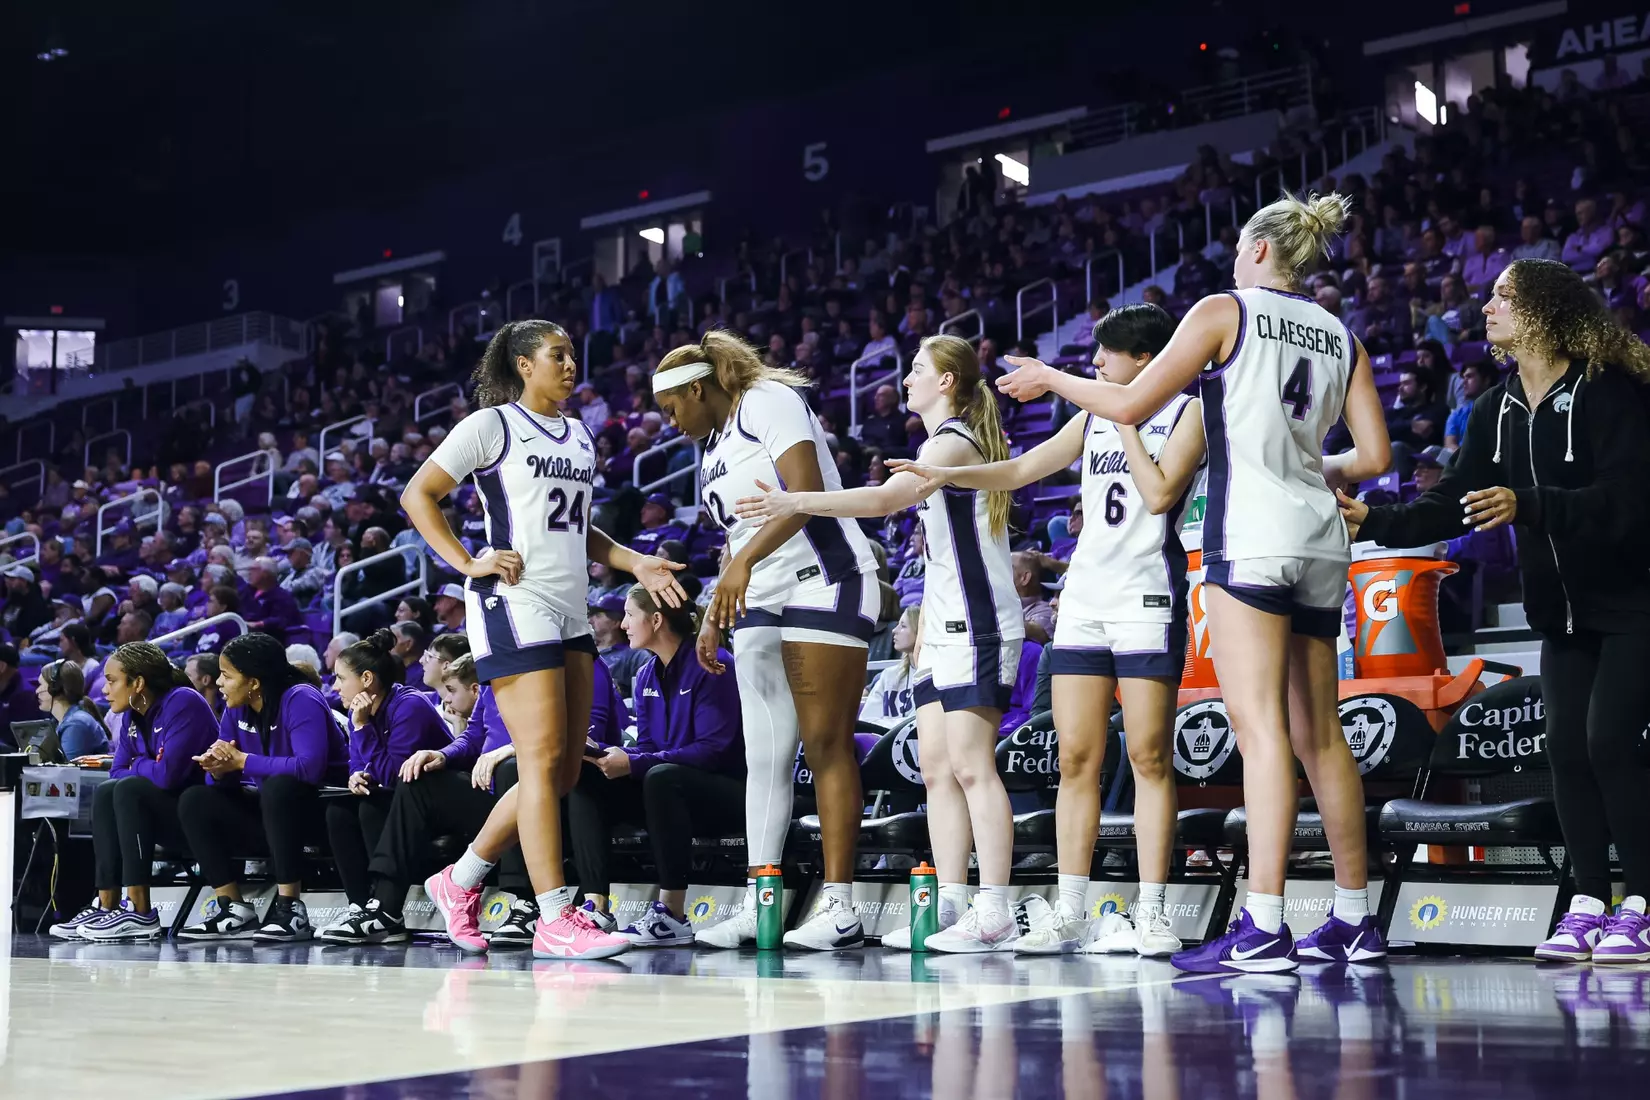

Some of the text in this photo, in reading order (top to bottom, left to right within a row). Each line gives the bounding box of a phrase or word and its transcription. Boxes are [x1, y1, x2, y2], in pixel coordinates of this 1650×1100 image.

[804, 142, 829, 181] 5
[502, 213, 523, 246] 4
[223, 280, 239, 310] 3
[1256, 314, 1342, 360] CLAESSENS
[1281, 356, 1312, 421] 4
[548, 487, 584, 535] 24
[1105, 482, 1127, 528] 6
[1363, 580, 1399, 621] G
[1460, 697, 1546, 731] Capit
[1457, 731, 1547, 759] Feder
[759, 887, 775, 906] G
[881, 902, 906, 915] FREE
[913, 886, 932, 907] G
[1171, 904, 1201, 917] FREE
[1285, 898, 1333, 912] HUNGER
[1450, 905, 1538, 922] HUNGER FREE
